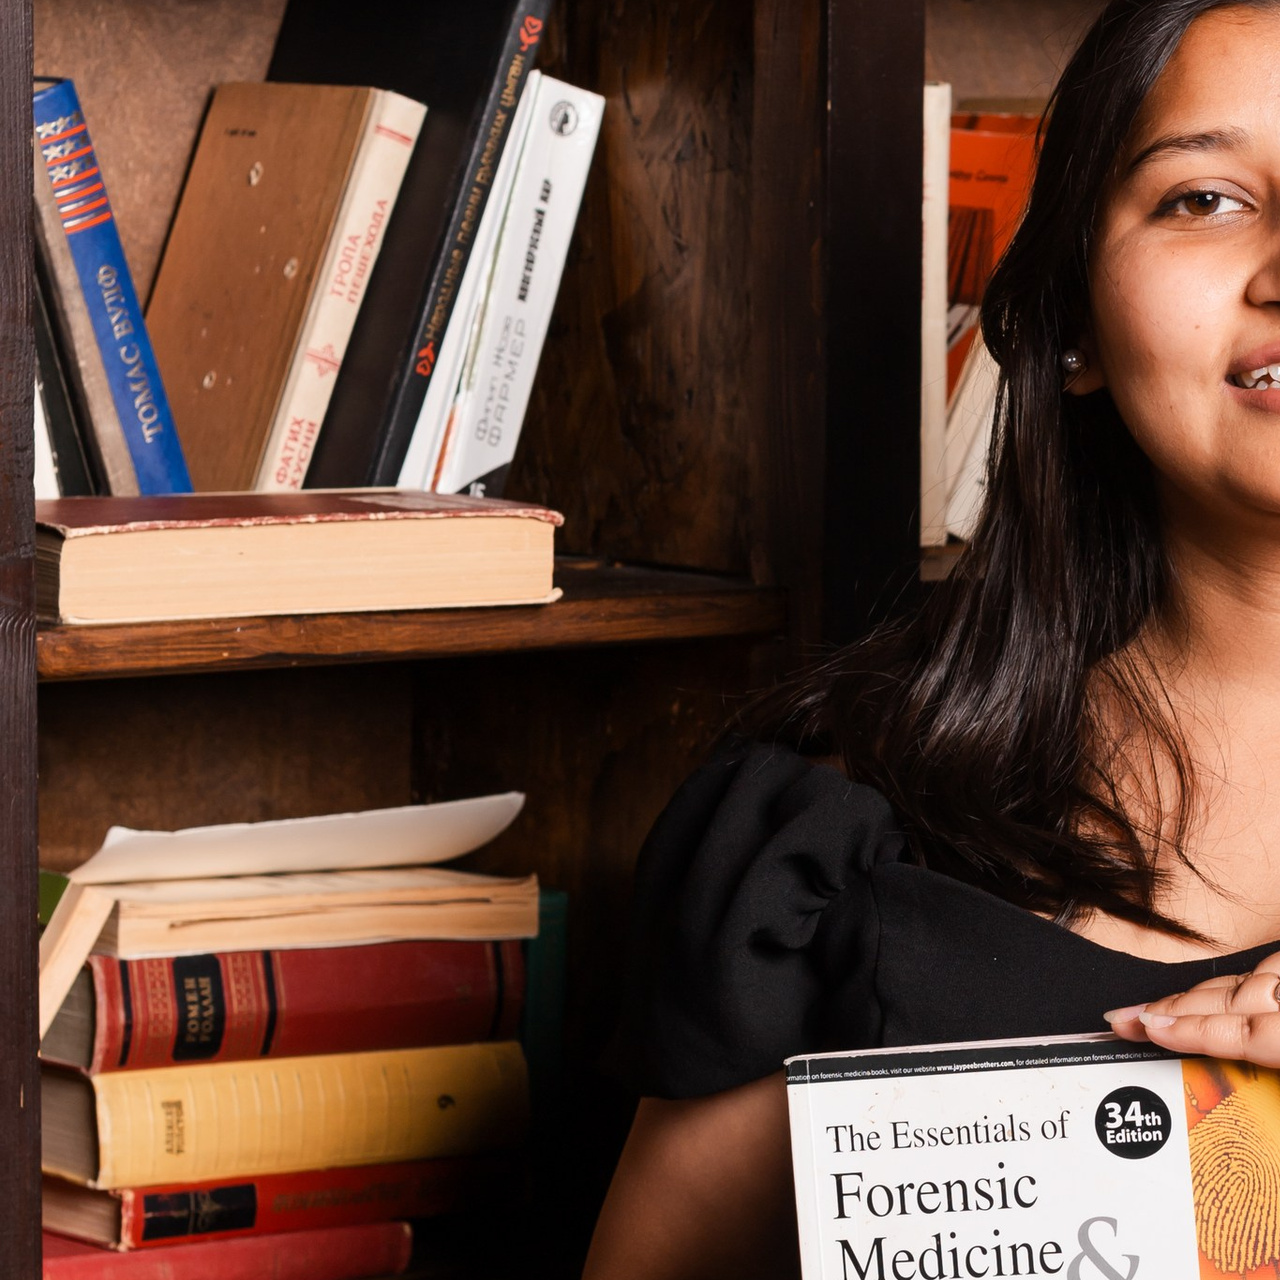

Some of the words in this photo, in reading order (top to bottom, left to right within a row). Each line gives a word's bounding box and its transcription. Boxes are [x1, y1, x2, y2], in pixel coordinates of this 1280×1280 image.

[328, 231, 364, 300] ТРОПА
[346, 198, 389, 306] ПЕШЕХОДА
[97, 263, 135, 341] ВУЛФ
[119, 343, 160, 445] ТОМАС
[487, 317, 528, 448] ФАРМЕР
[274, 414, 305, 487] ФАТИХ
[286, 419, 318, 491] ХУСНИ
[820, 1071, 844, 1080] forensic
[1016, 1058, 1025, 1067] for
[1025, 1056, 1049, 1066] detailed
[1049, 1054, 1083, 1065] information
[1092, 1052, 1115, 1062] forensic
[1115, 1051, 1143, 1061] medicine
[826, 1124, 883, 1154] The
[890, 1113, 1032, 1150] Essentials
[1040, 1110, 1071, 1141] of
[1103, 1100, 1162, 1129] 34th
[1105, 1127, 1164, 1145] Edition
[829, 1161, 1040, 1220] Forensic
